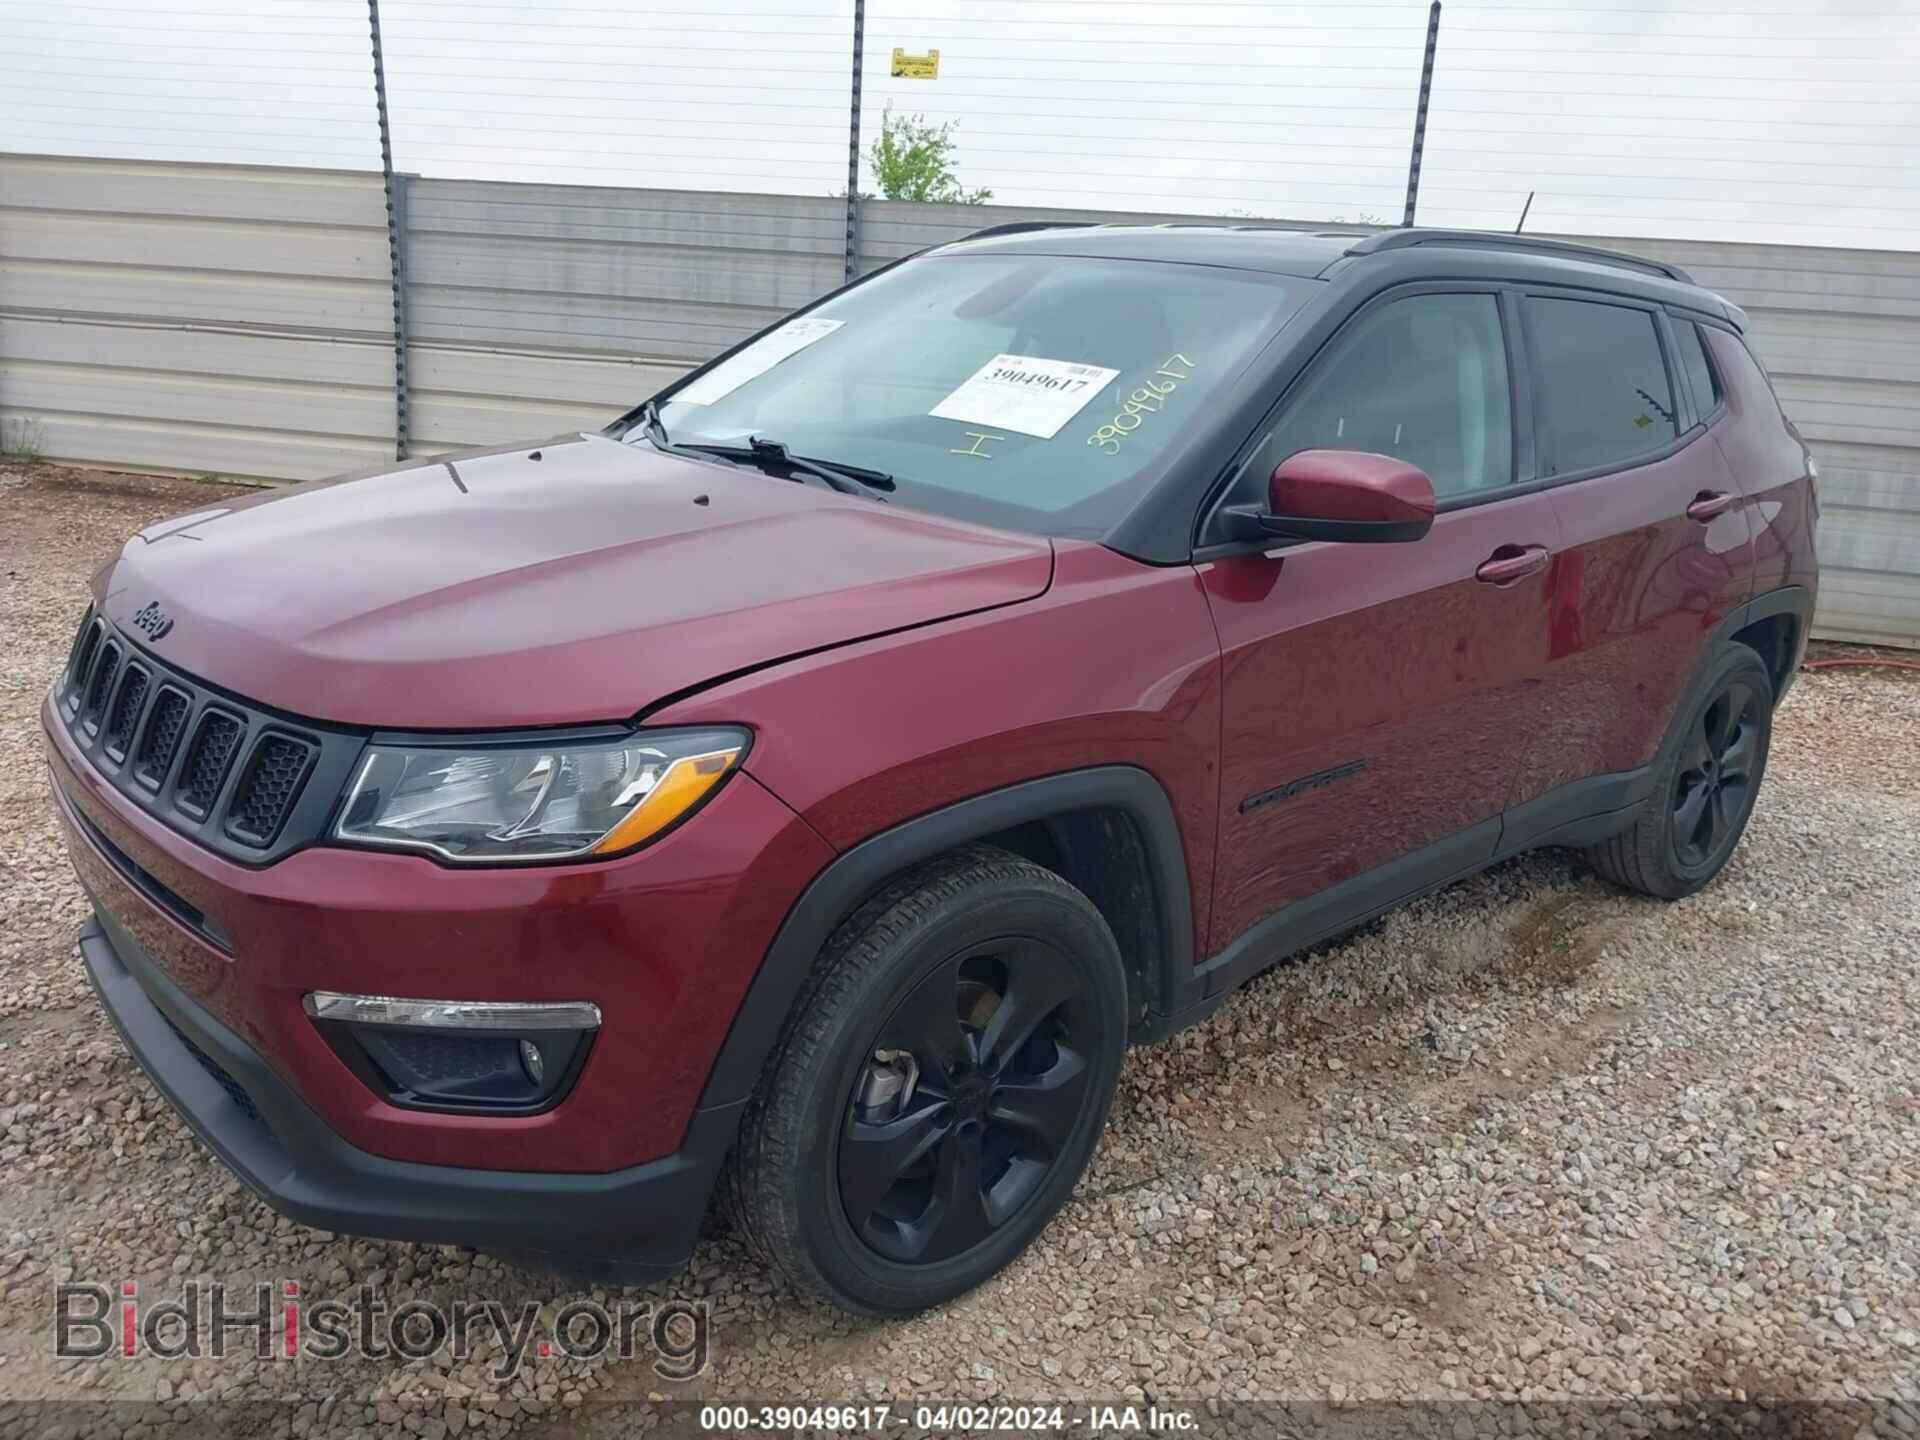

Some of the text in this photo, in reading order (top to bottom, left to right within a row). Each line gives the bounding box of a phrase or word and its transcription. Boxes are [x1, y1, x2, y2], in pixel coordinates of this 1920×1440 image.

[984, 367, 1089, 393] 39049617
[1086, 353, 1196, 456] 39049617
[133, 600, 174, 643] Jeep
